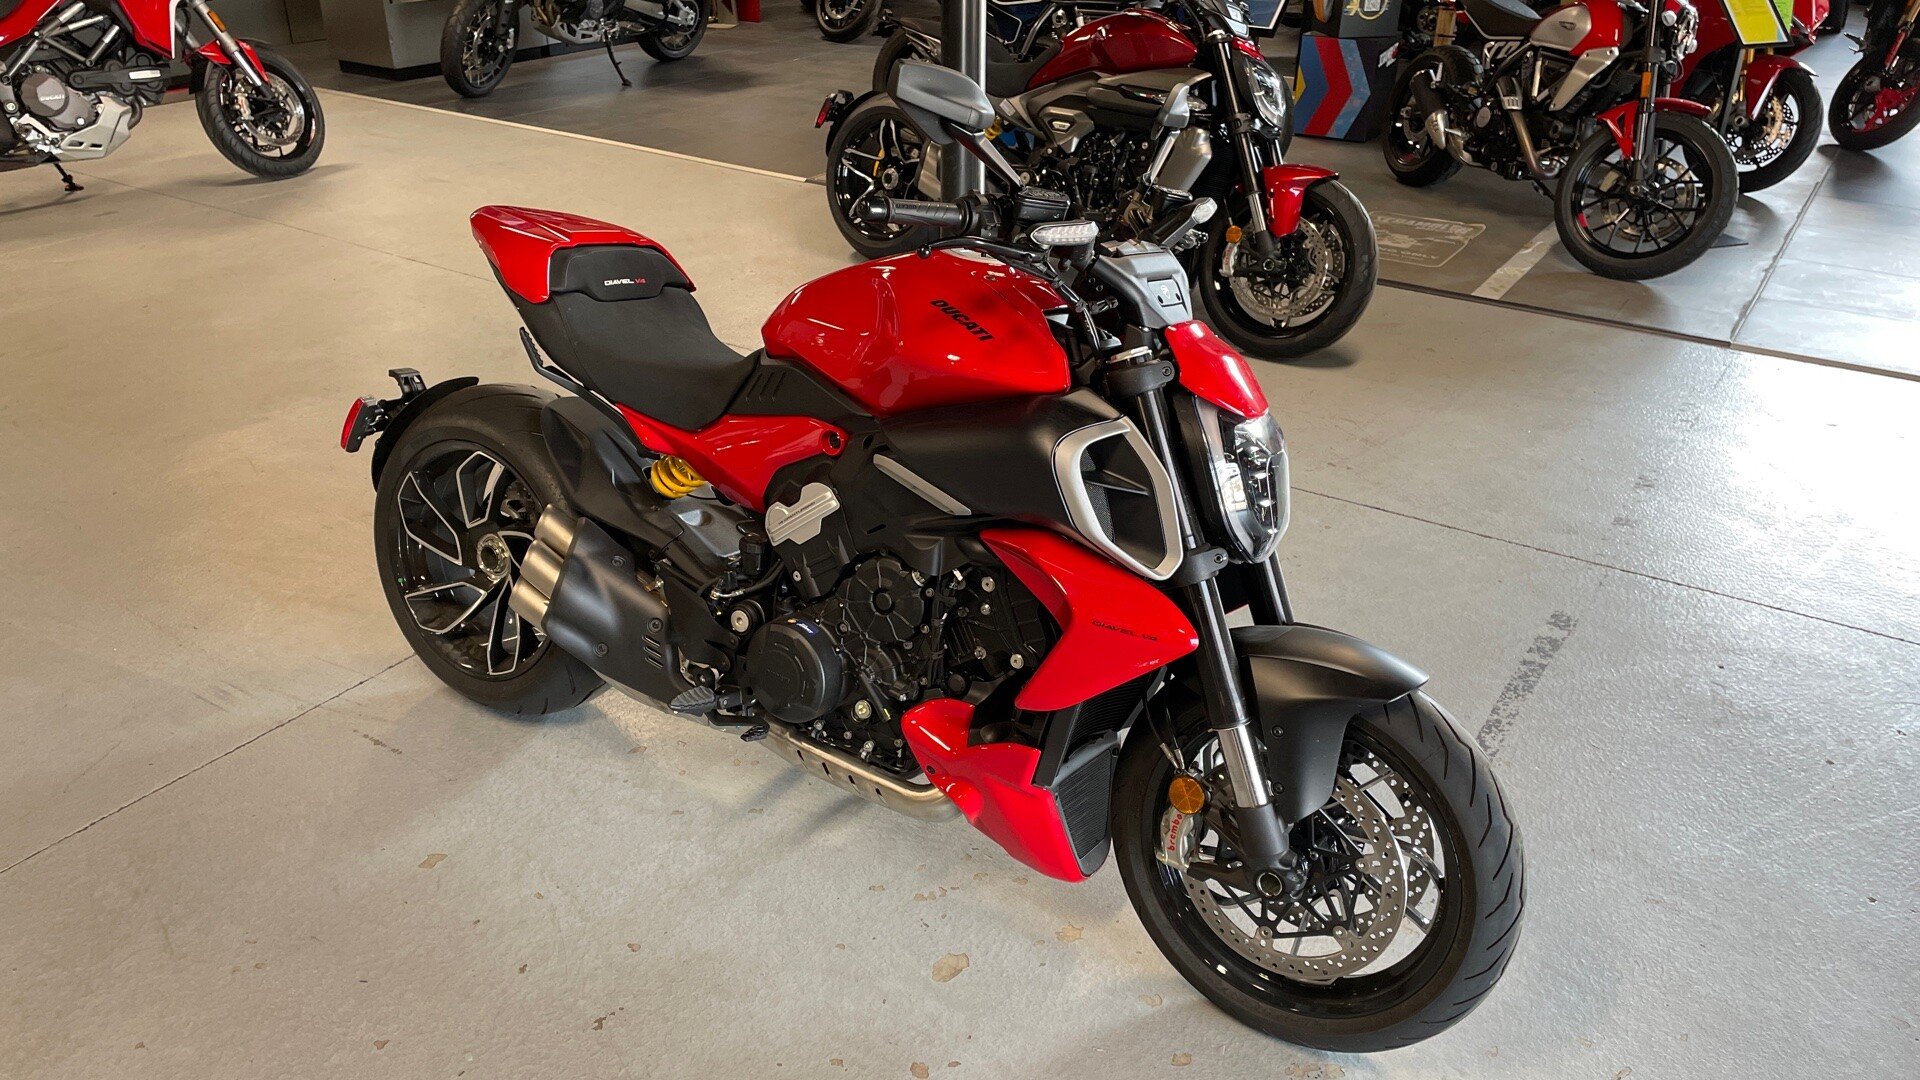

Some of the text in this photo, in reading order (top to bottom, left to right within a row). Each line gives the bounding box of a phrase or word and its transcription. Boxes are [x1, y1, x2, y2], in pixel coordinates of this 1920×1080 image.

[604, 278, 634, 286] DIAVEL
[931, 299, 994, 341] DUCATI
[1167, 813, 1183, 851] brembo
